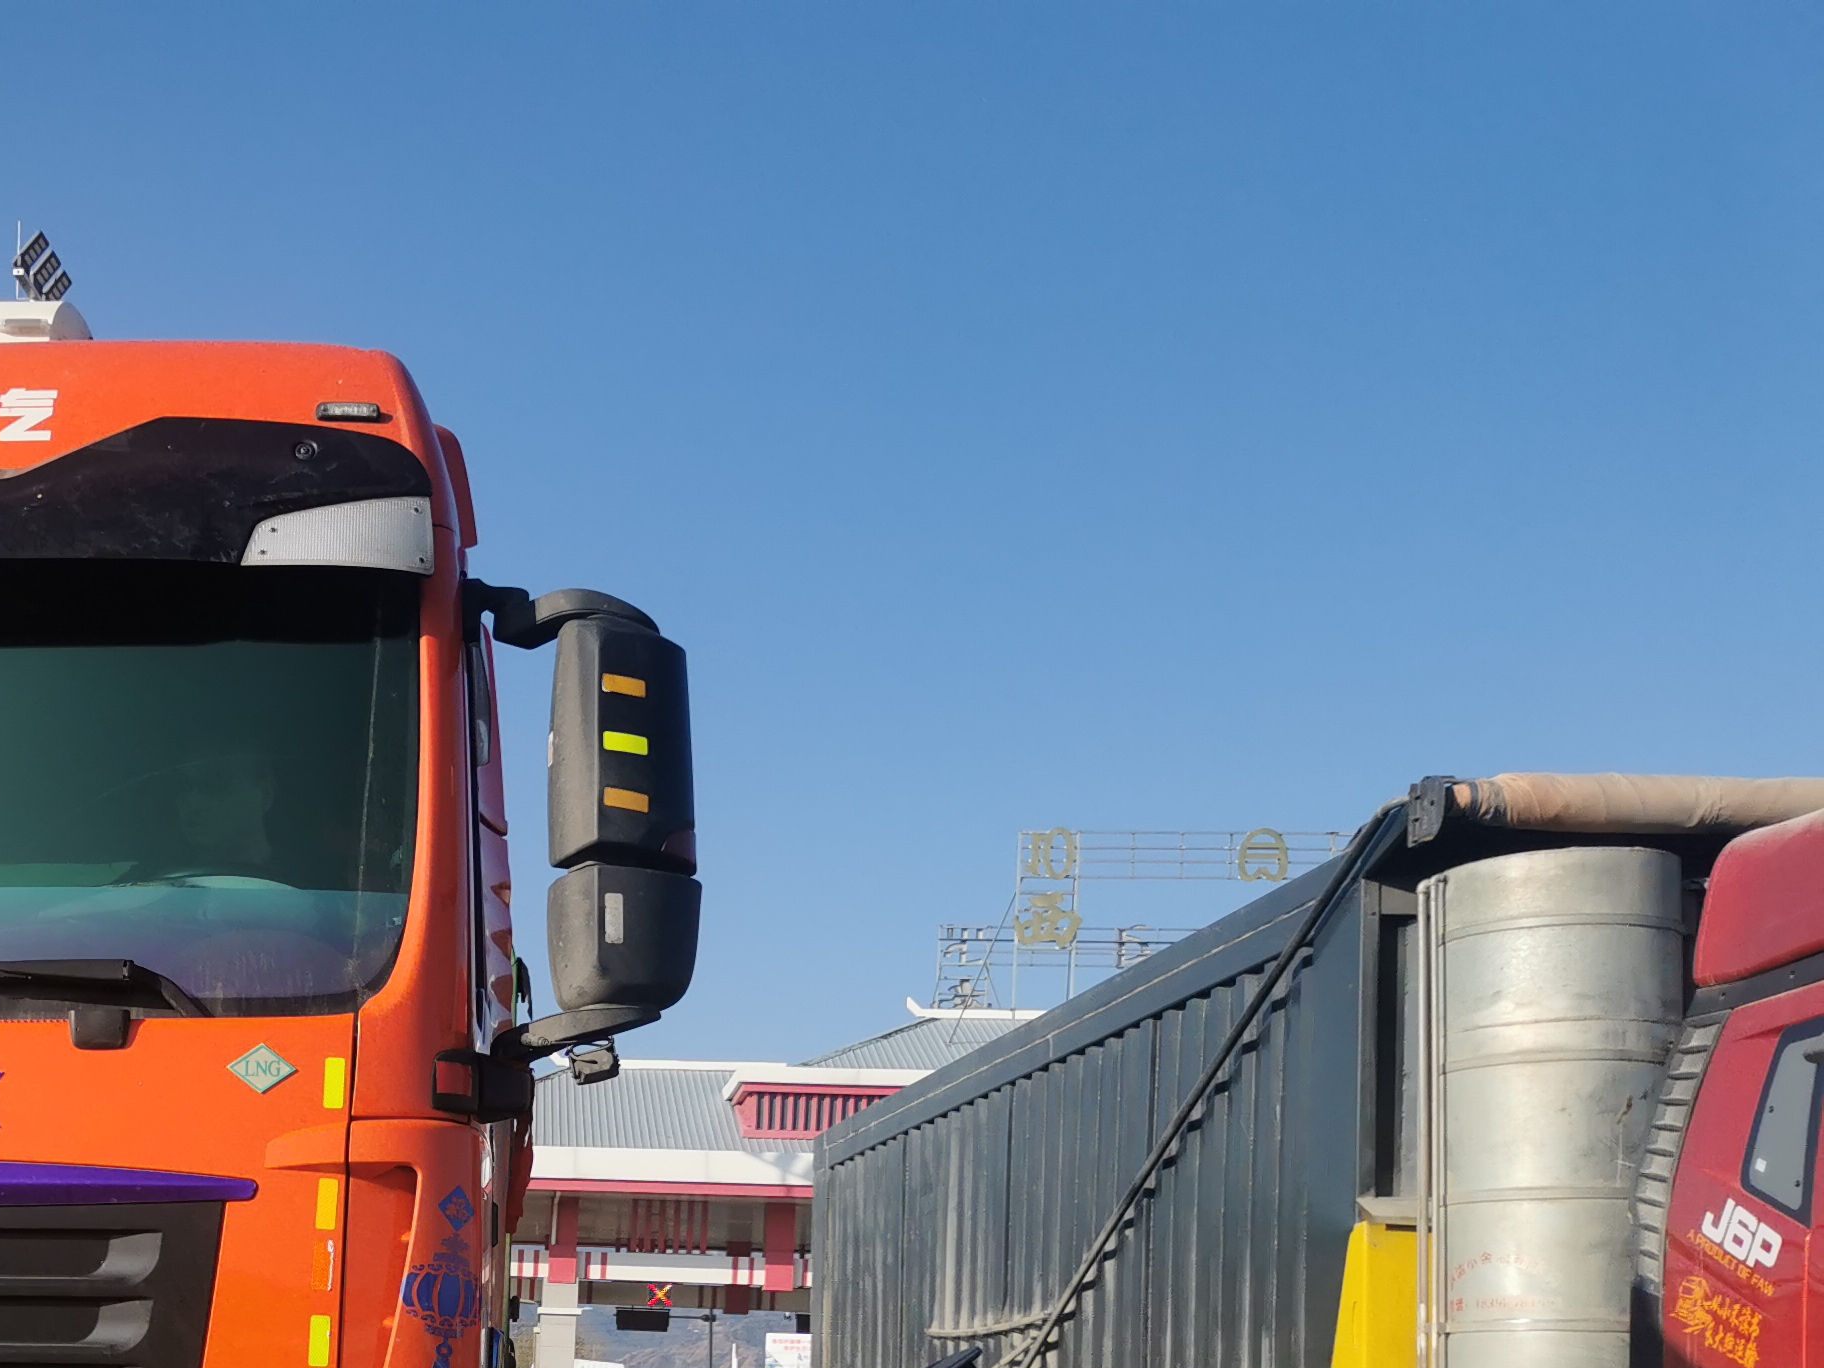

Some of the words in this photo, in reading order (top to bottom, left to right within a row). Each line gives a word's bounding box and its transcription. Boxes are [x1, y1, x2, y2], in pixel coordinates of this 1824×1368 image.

[243, 1059, 281, 1077] LNG
[1701, 1197, 1782, 1268] J6P
[1696, 1233, 1738, 1271] PRODUCT
[1751, 1273, 1775, 1297] FAW
